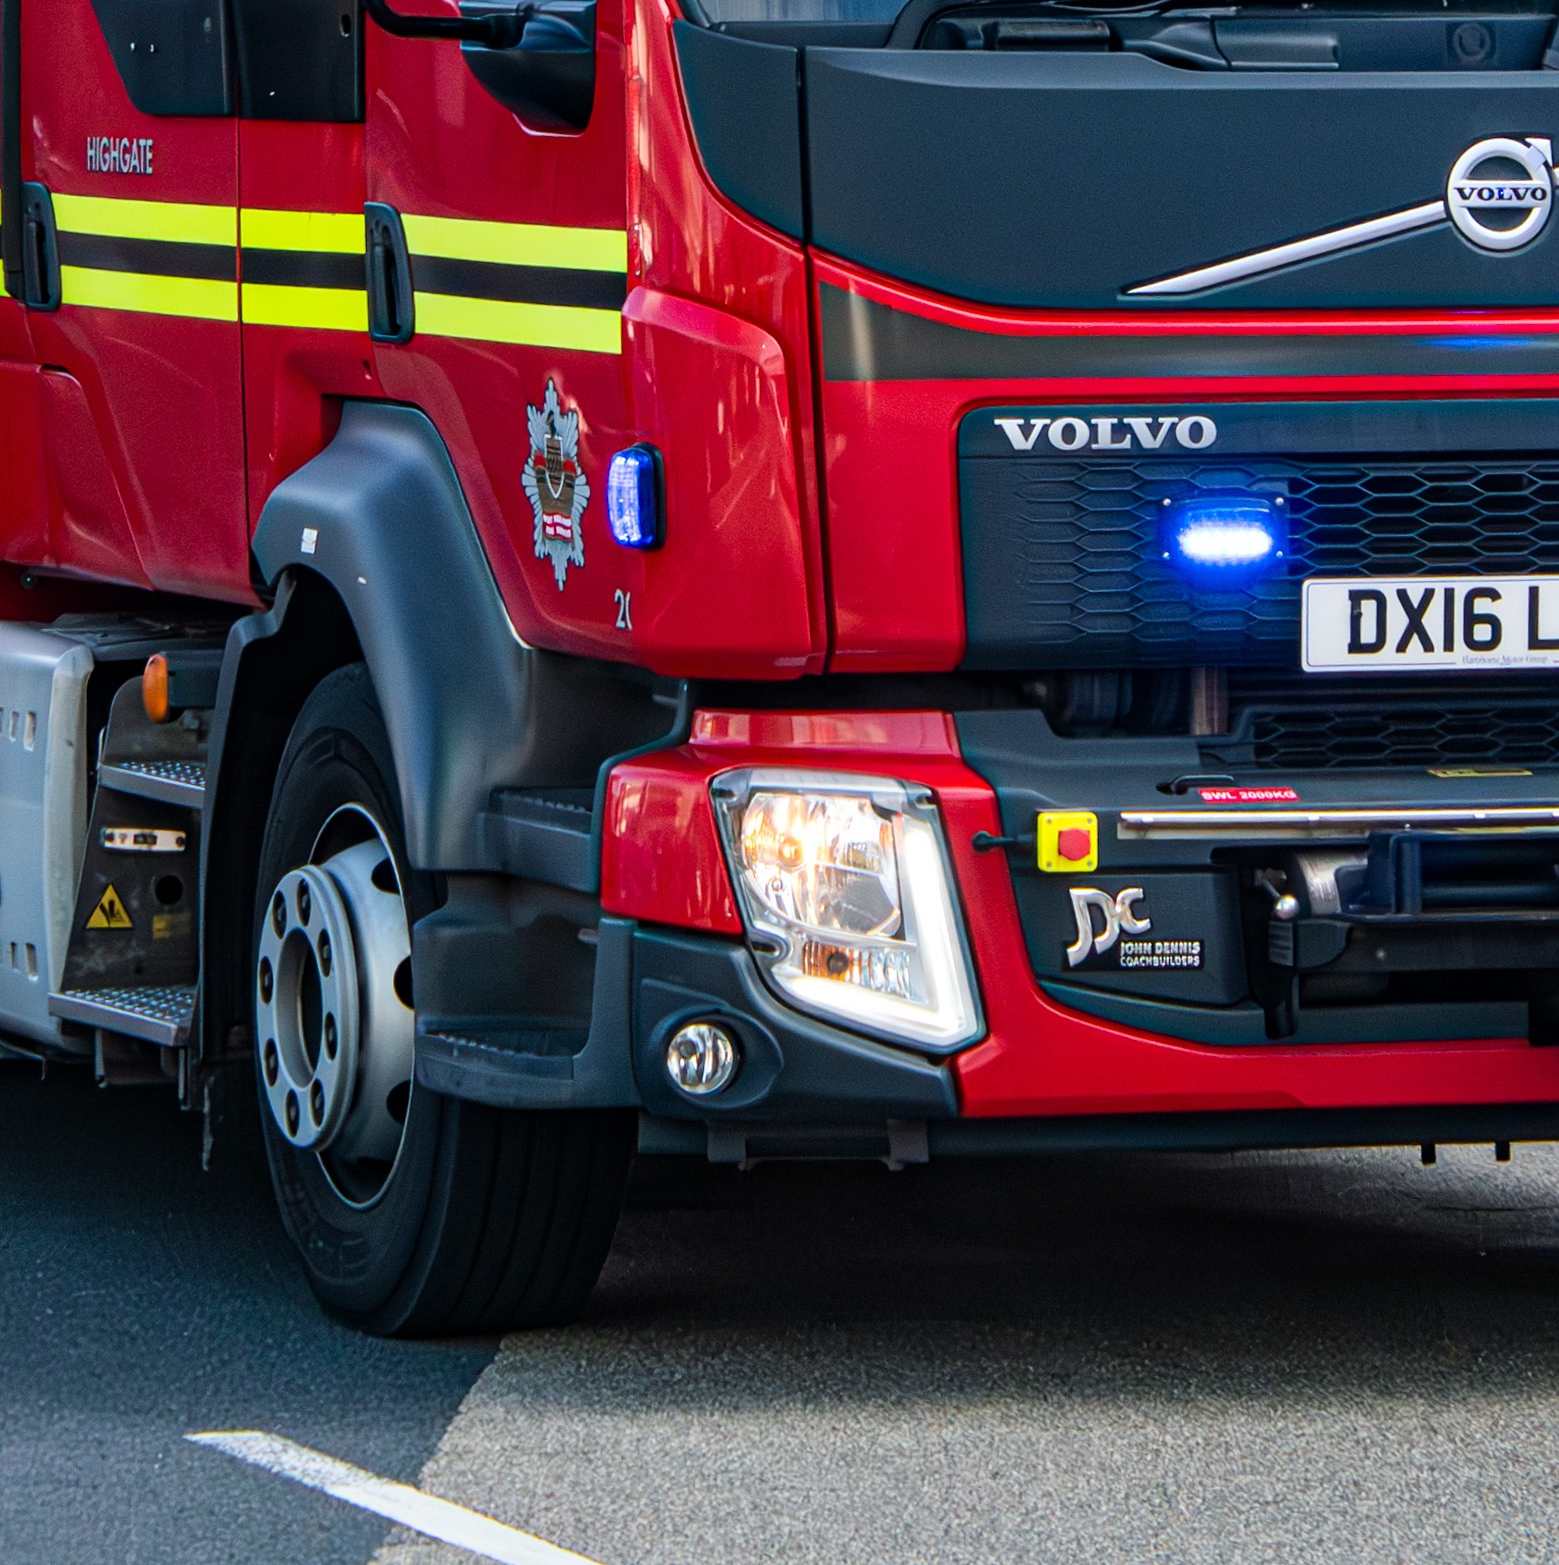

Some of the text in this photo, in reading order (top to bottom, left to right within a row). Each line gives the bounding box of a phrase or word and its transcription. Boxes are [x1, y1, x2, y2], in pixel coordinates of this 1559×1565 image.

[85, 135, 154, 175] HIGHGATE
[1453, 186, 1548, 201] VOLVO
[993, 414, 1218, 452] VOLVO
[1347, 585, 1502, 654] DX16
[1201, 789, 1298, 801] SWL 2000KG
[1120, 941, 1201, 955] JOHN DENNIS
[1120, 955, 1200, 968] COACHBUILDERS
